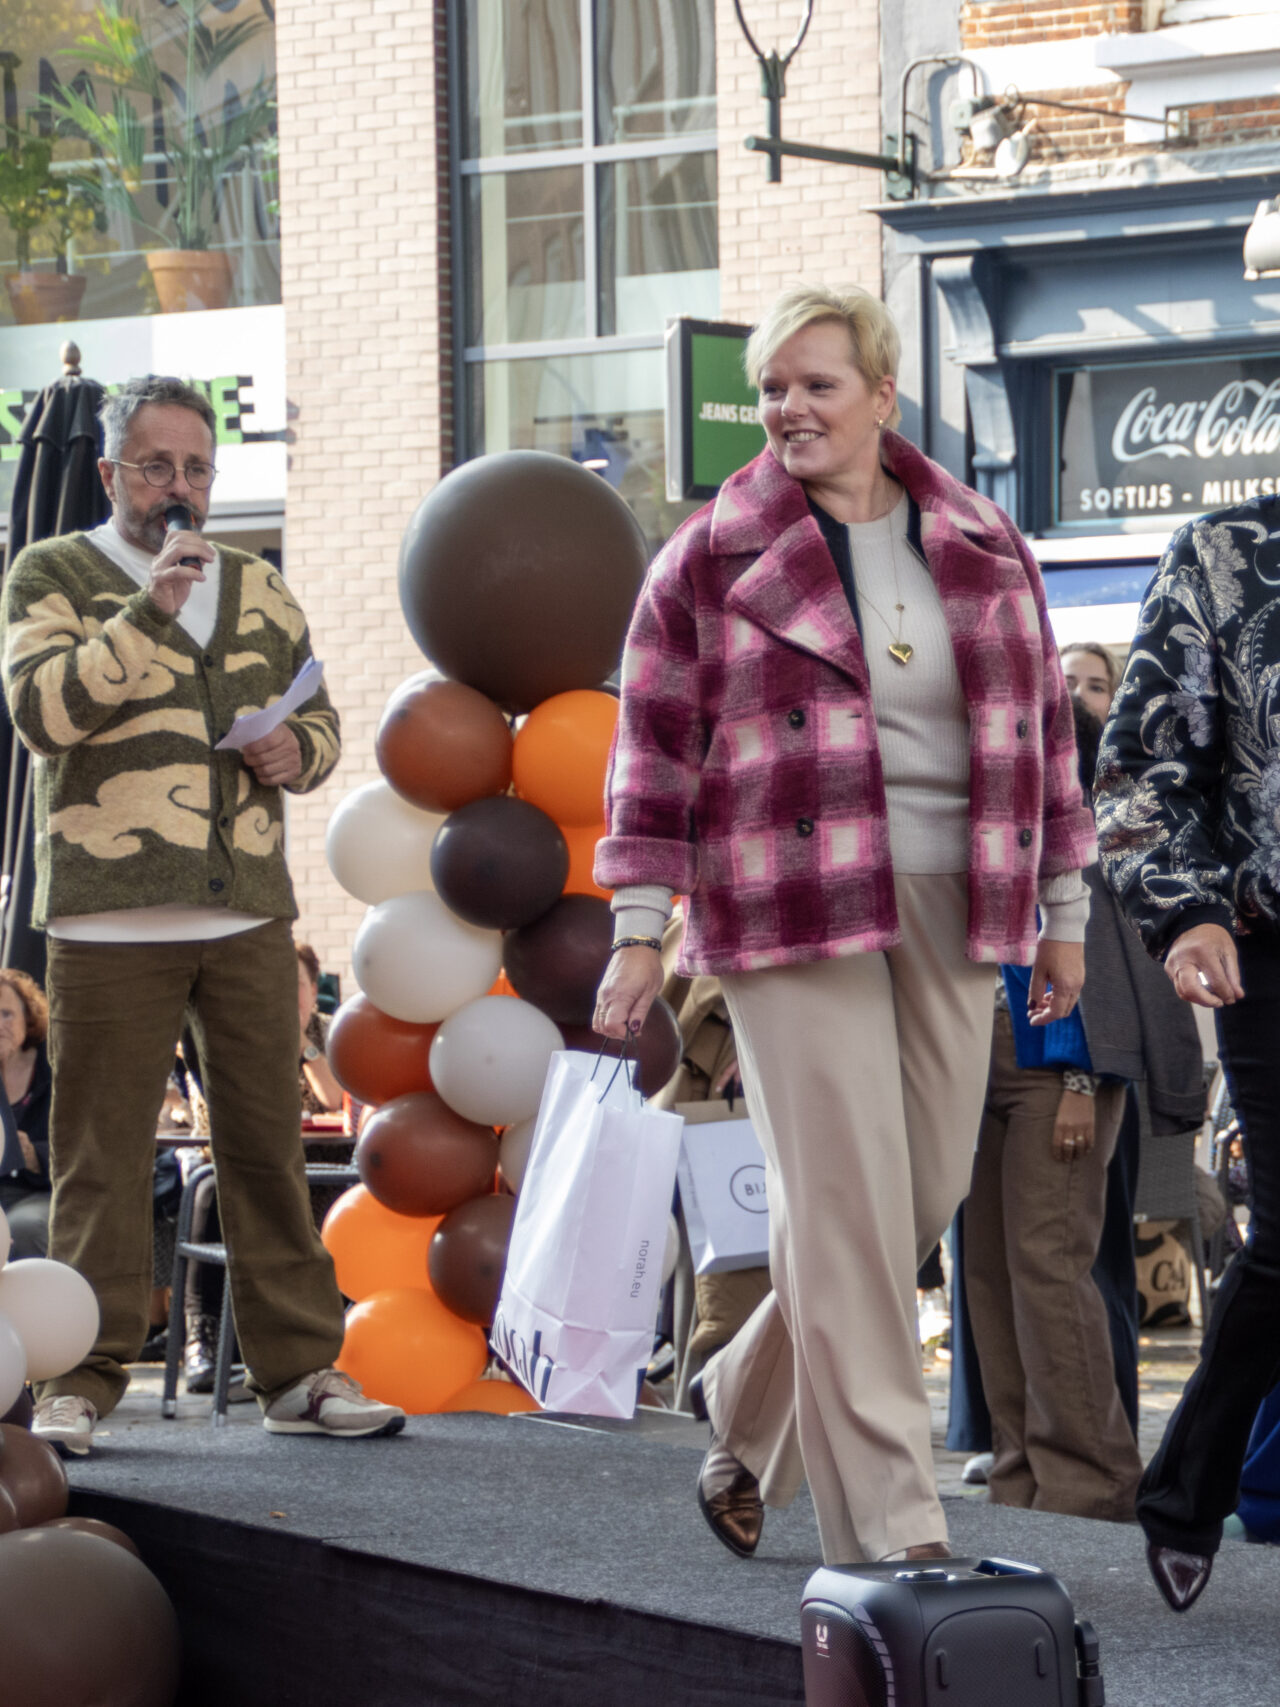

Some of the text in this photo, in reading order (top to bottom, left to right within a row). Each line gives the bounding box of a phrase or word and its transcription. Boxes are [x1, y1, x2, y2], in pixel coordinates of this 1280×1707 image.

[699, 402, 738, 422] JEANS
[1080, 483, 1173, 511] SOFTIJS
[630, 1239, 650, 1299] norah.eu
